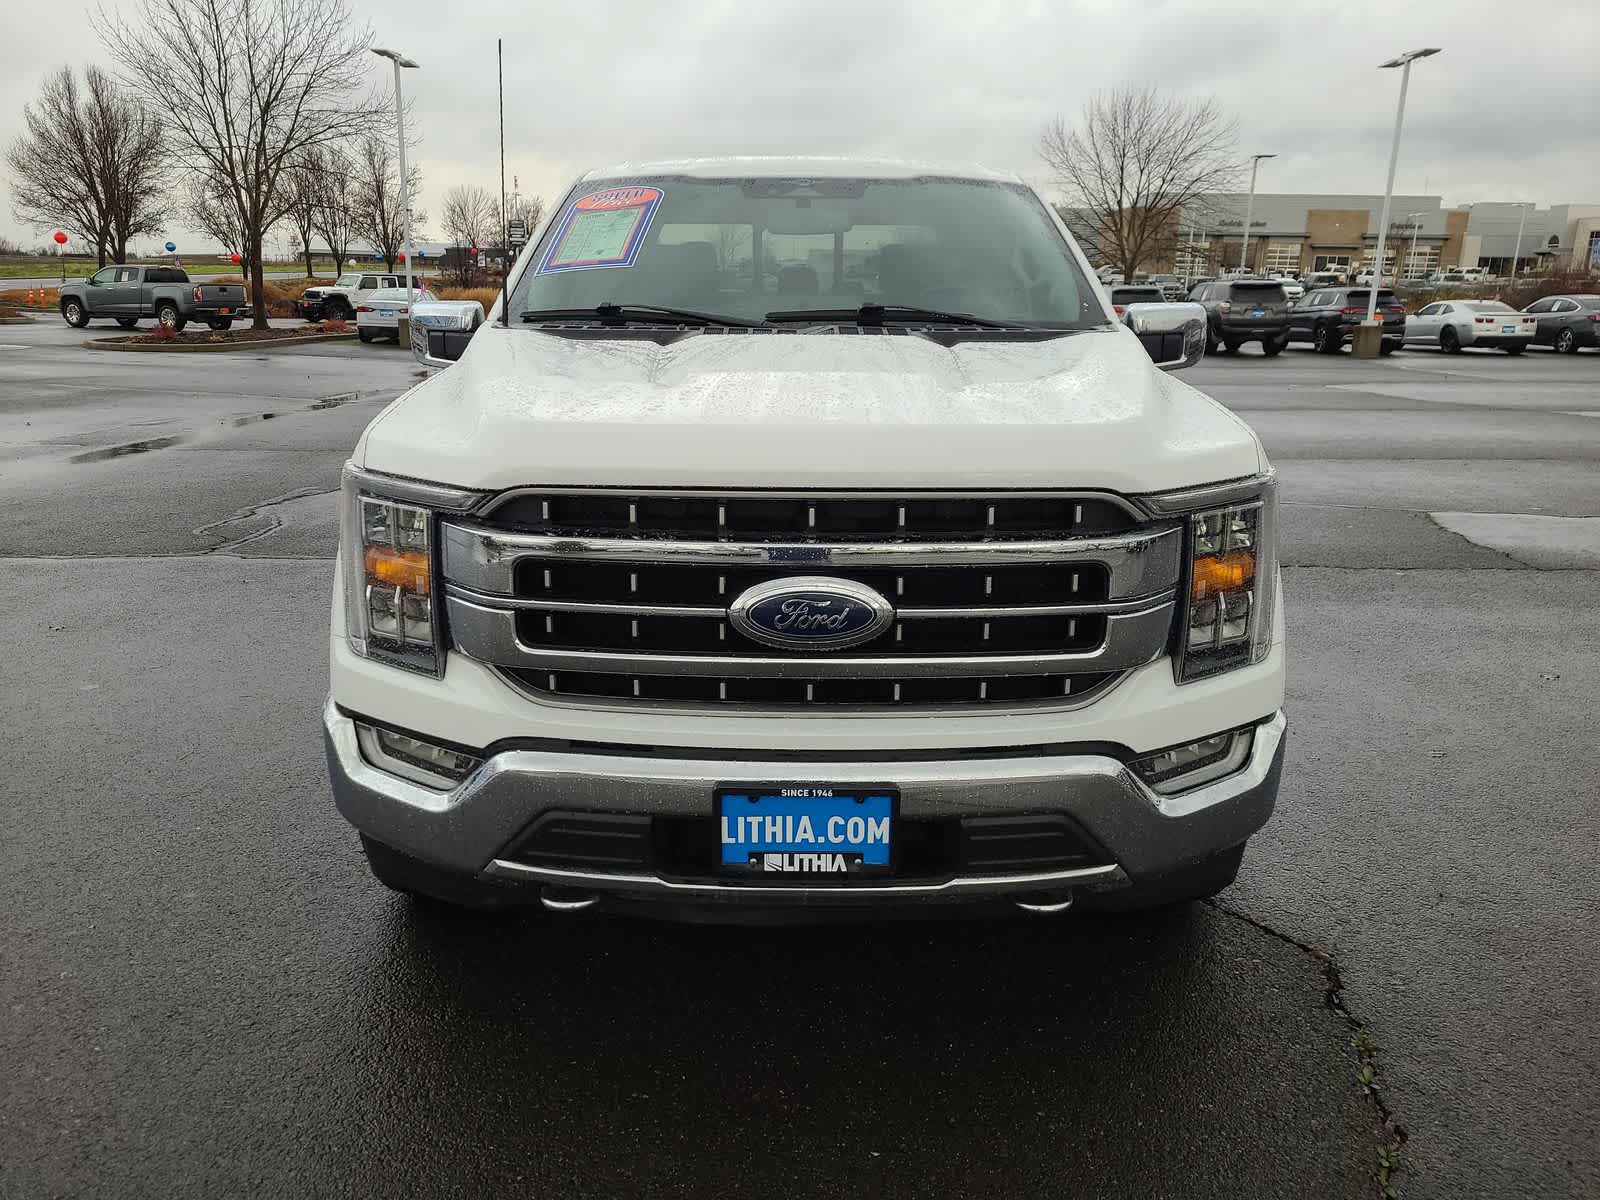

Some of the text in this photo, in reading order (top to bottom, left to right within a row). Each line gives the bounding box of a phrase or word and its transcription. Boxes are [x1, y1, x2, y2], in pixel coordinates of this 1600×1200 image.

[774, 599, 849, 630] Ford
[781, 789, 833, 797] SINCE 1946
[721, 815, 890, 844] LITHIA.COM
[782, 853, 848, 872] LITHIA
